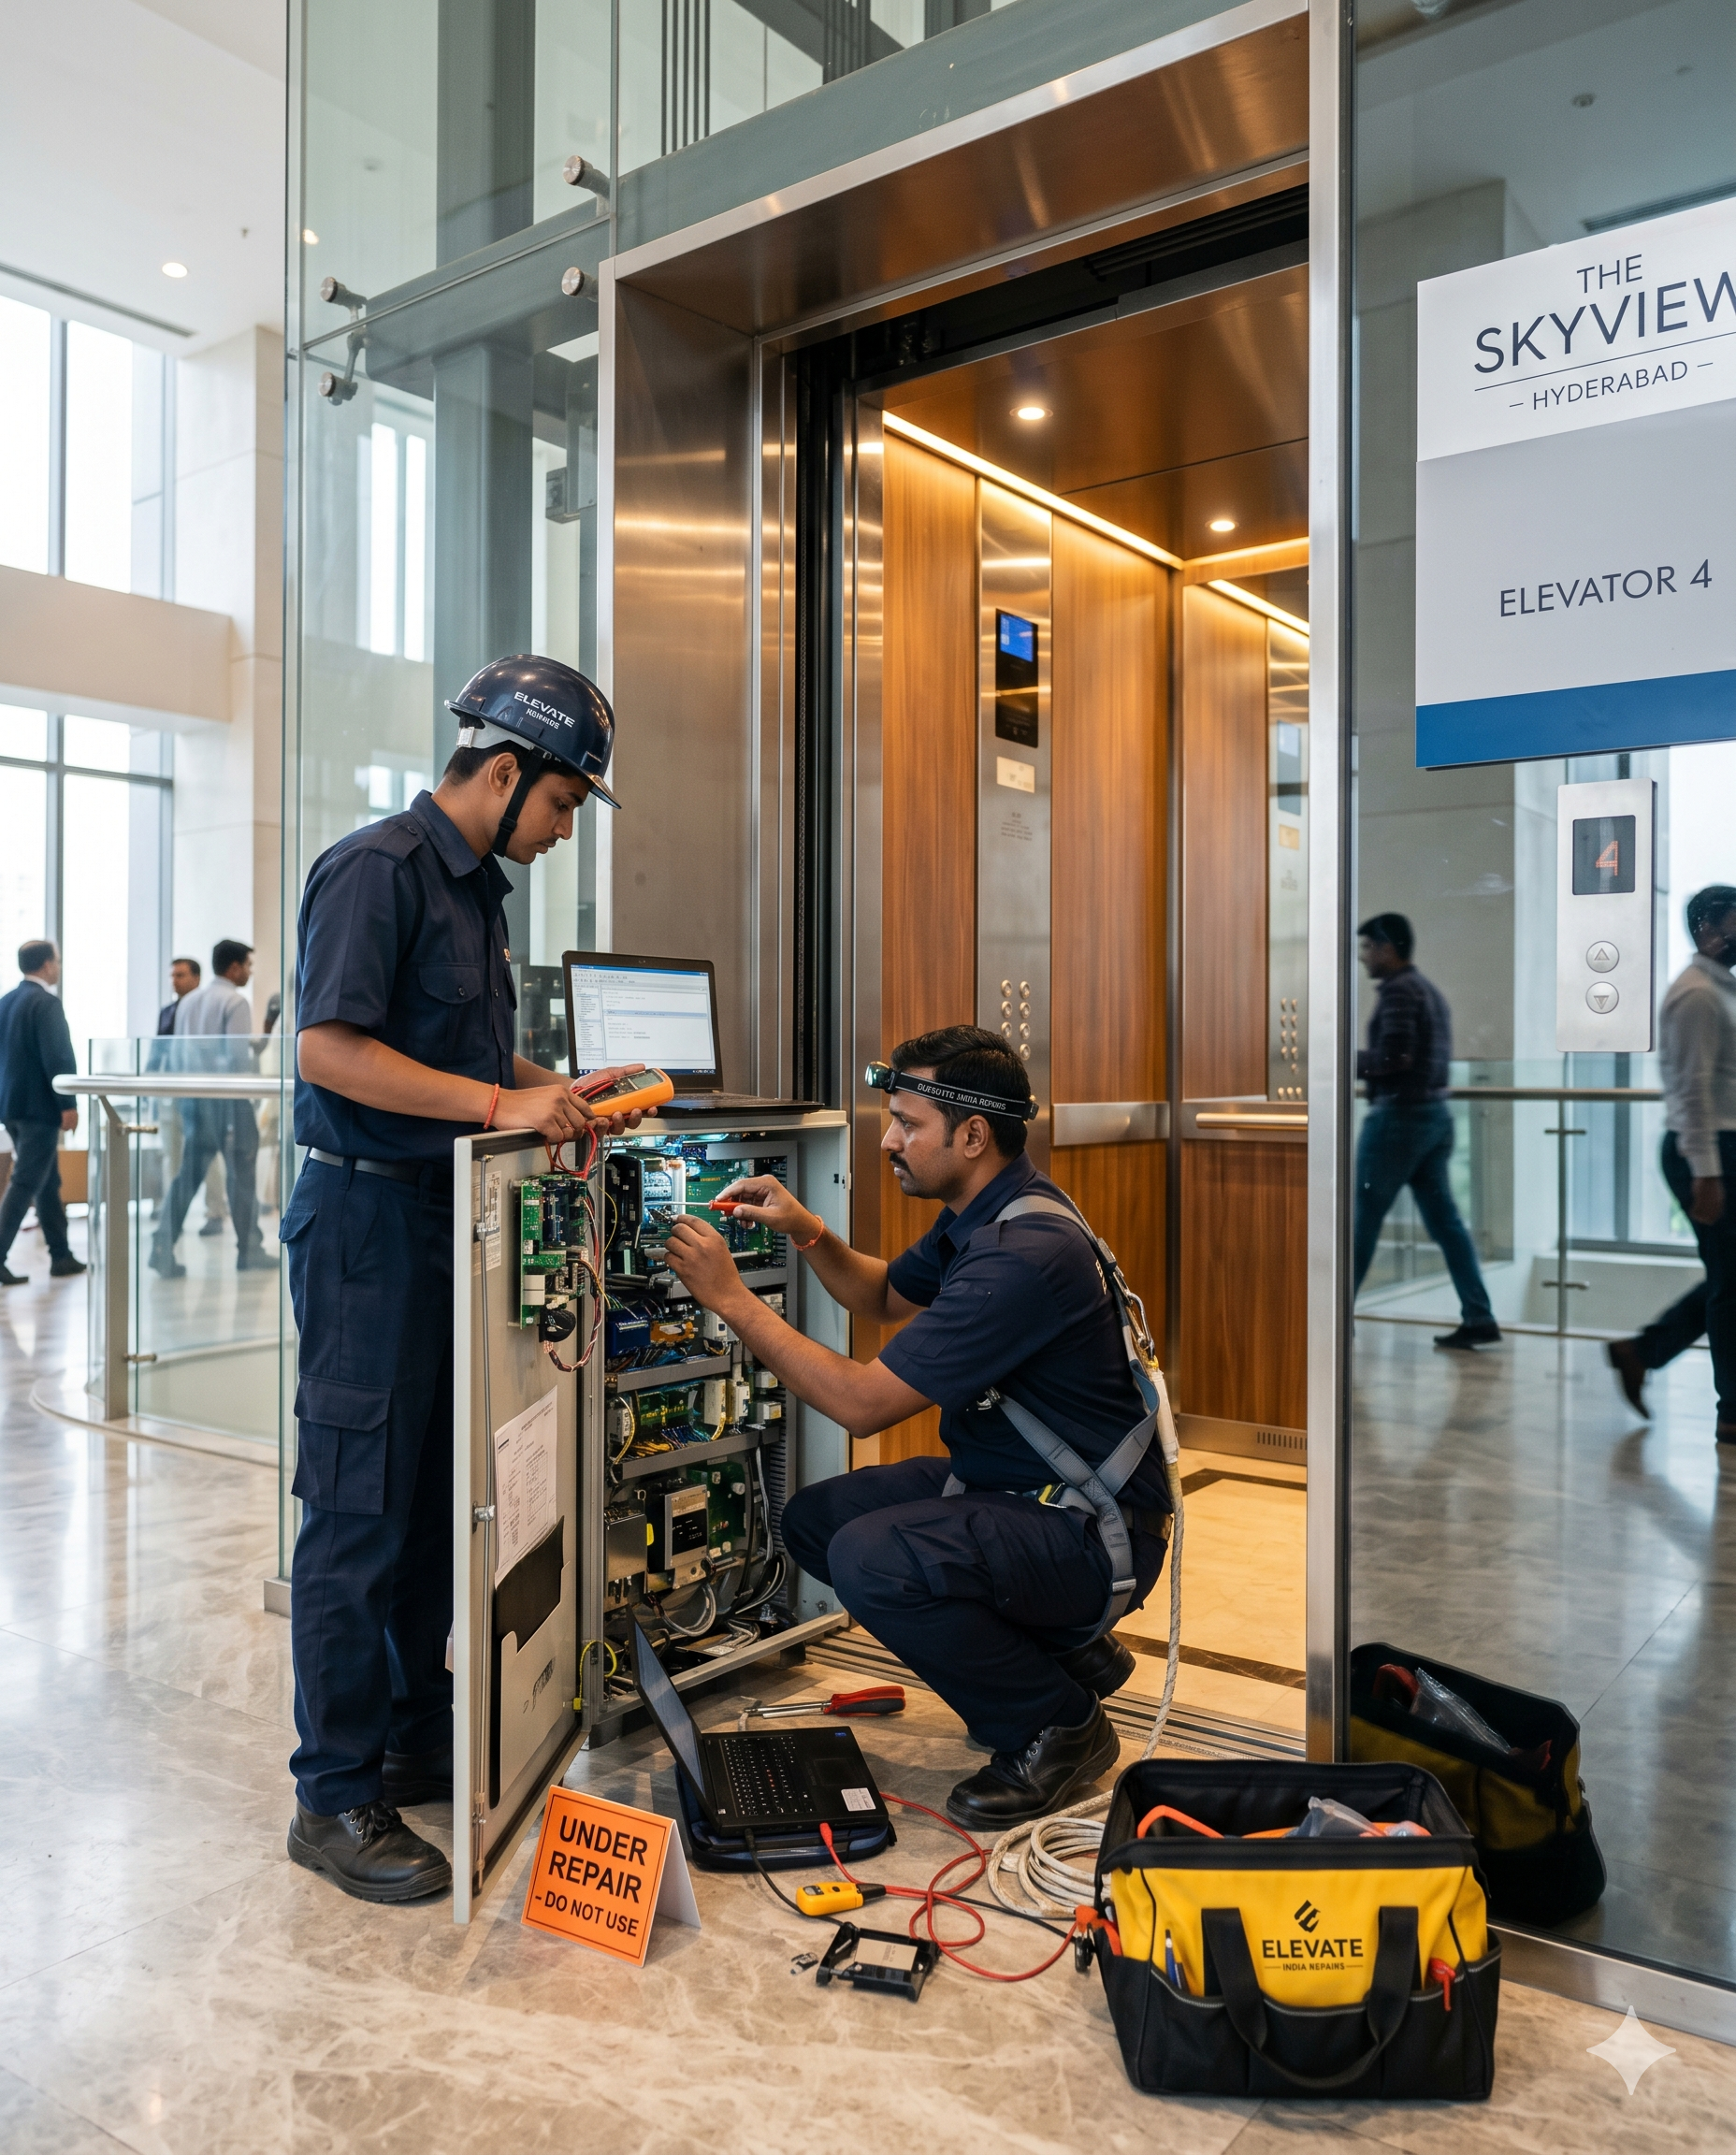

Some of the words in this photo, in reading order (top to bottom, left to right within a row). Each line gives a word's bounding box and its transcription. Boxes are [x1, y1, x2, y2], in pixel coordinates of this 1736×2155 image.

[1576, 253, 1643, 294] THE
[1474, 271, 1736, 373] SKYVIEW
[1533, 360, 1688, 411] HYDERABAD
[1500, 565, 1678, 617] ELEVATOR
[1689, 558, 1713, 588] 4
[514, 691, 575, 728] ELEVATE
[1596, 840, 1619, 876] 4
[559, 1815, 648, 1866] UNDER
[548, 1850, 643, 1904] REPAIR
[544, 1890, 568, 1912] DO
[571, 1899, 604, 1924] NOT
[606, 1910, 640, 1937] USE
[1262, 1939, 1364, 1959] ELEVATE
[1282, 1963, 1307, 1972] INDIA
